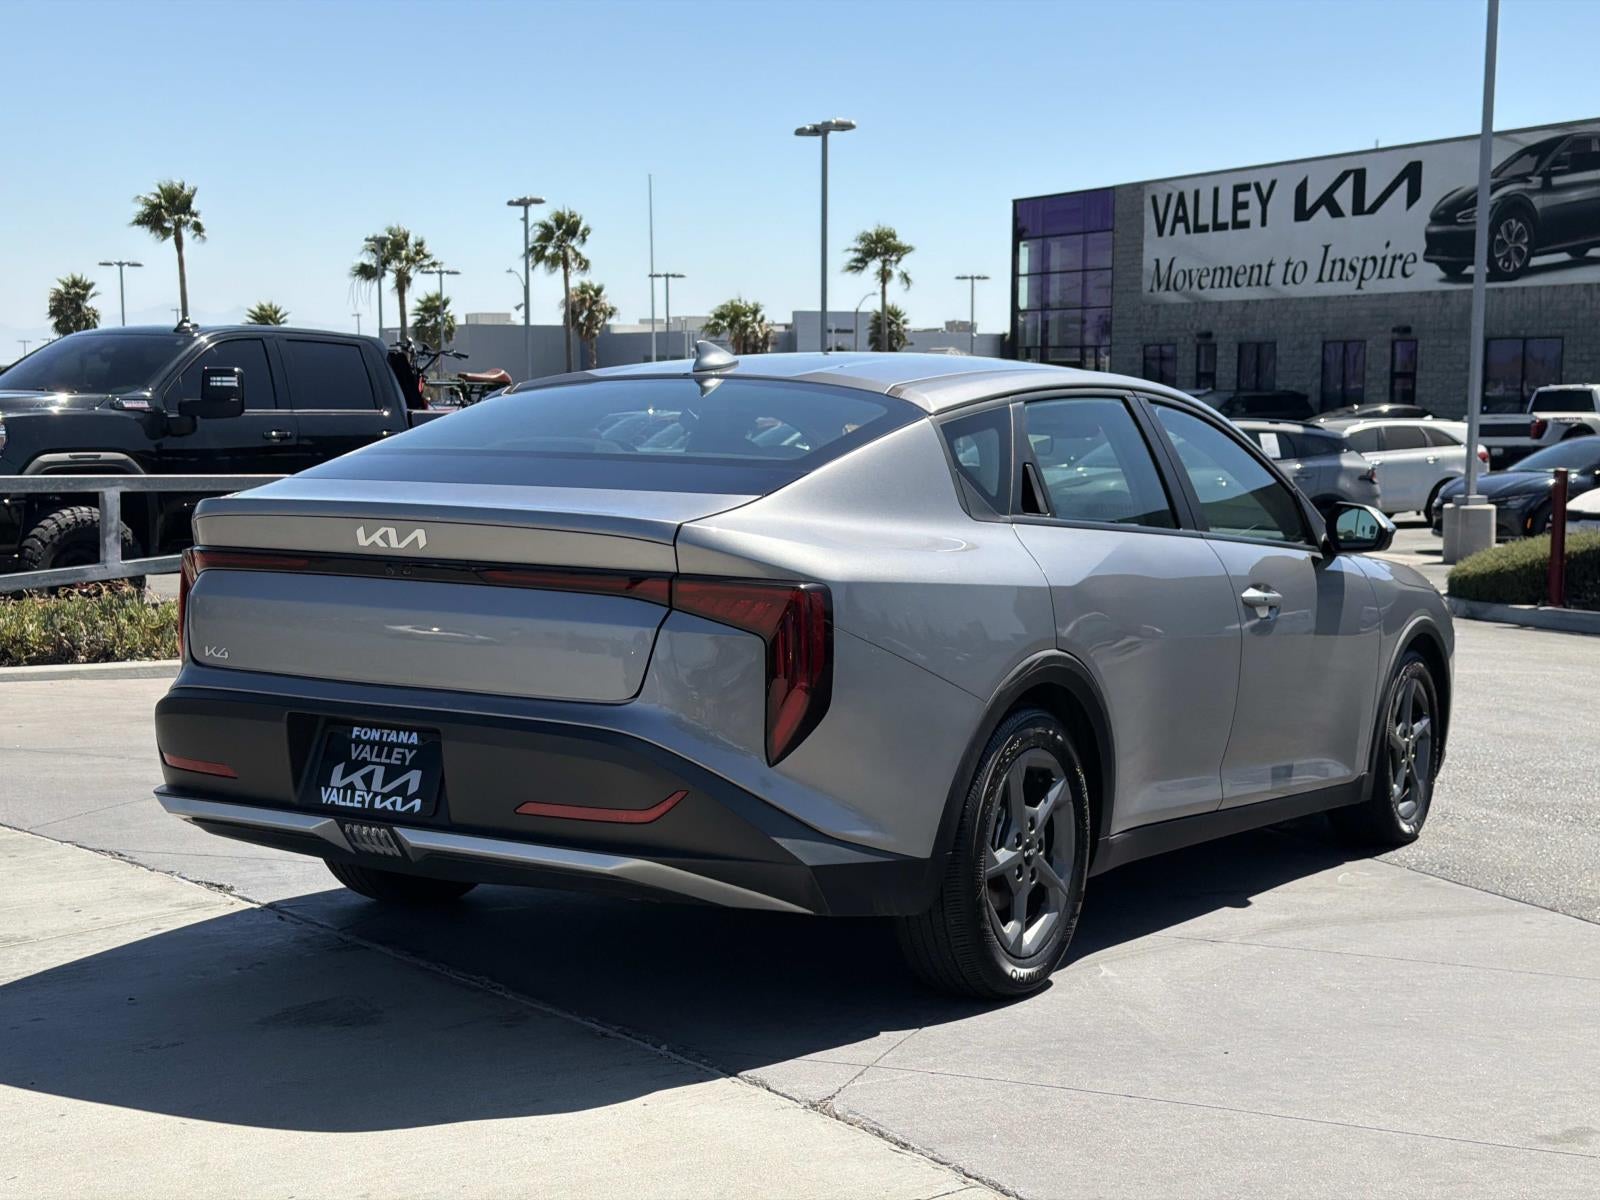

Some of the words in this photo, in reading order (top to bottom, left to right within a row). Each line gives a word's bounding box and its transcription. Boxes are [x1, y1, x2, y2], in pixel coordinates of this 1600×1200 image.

[1151, 179, 1277, 237] VALLEY
[1294, 160, 1423, 222] KIA
[1149, 256, 1276, 293] Movement
[1282, 256, 1308, 286] to
[1315, 240, 1417, 290] Inspire
[356, 526, 427, 549] KIA
[205, 645, 229, 660] K4
[352, 727, 418, 745] FONTANA
[351, 743, 418, 766] VALLEY
[330, 761, 422, 797] KIA
[321, 786, 374, 809] VALLEY
[374, 794, 422, 814] KIA
